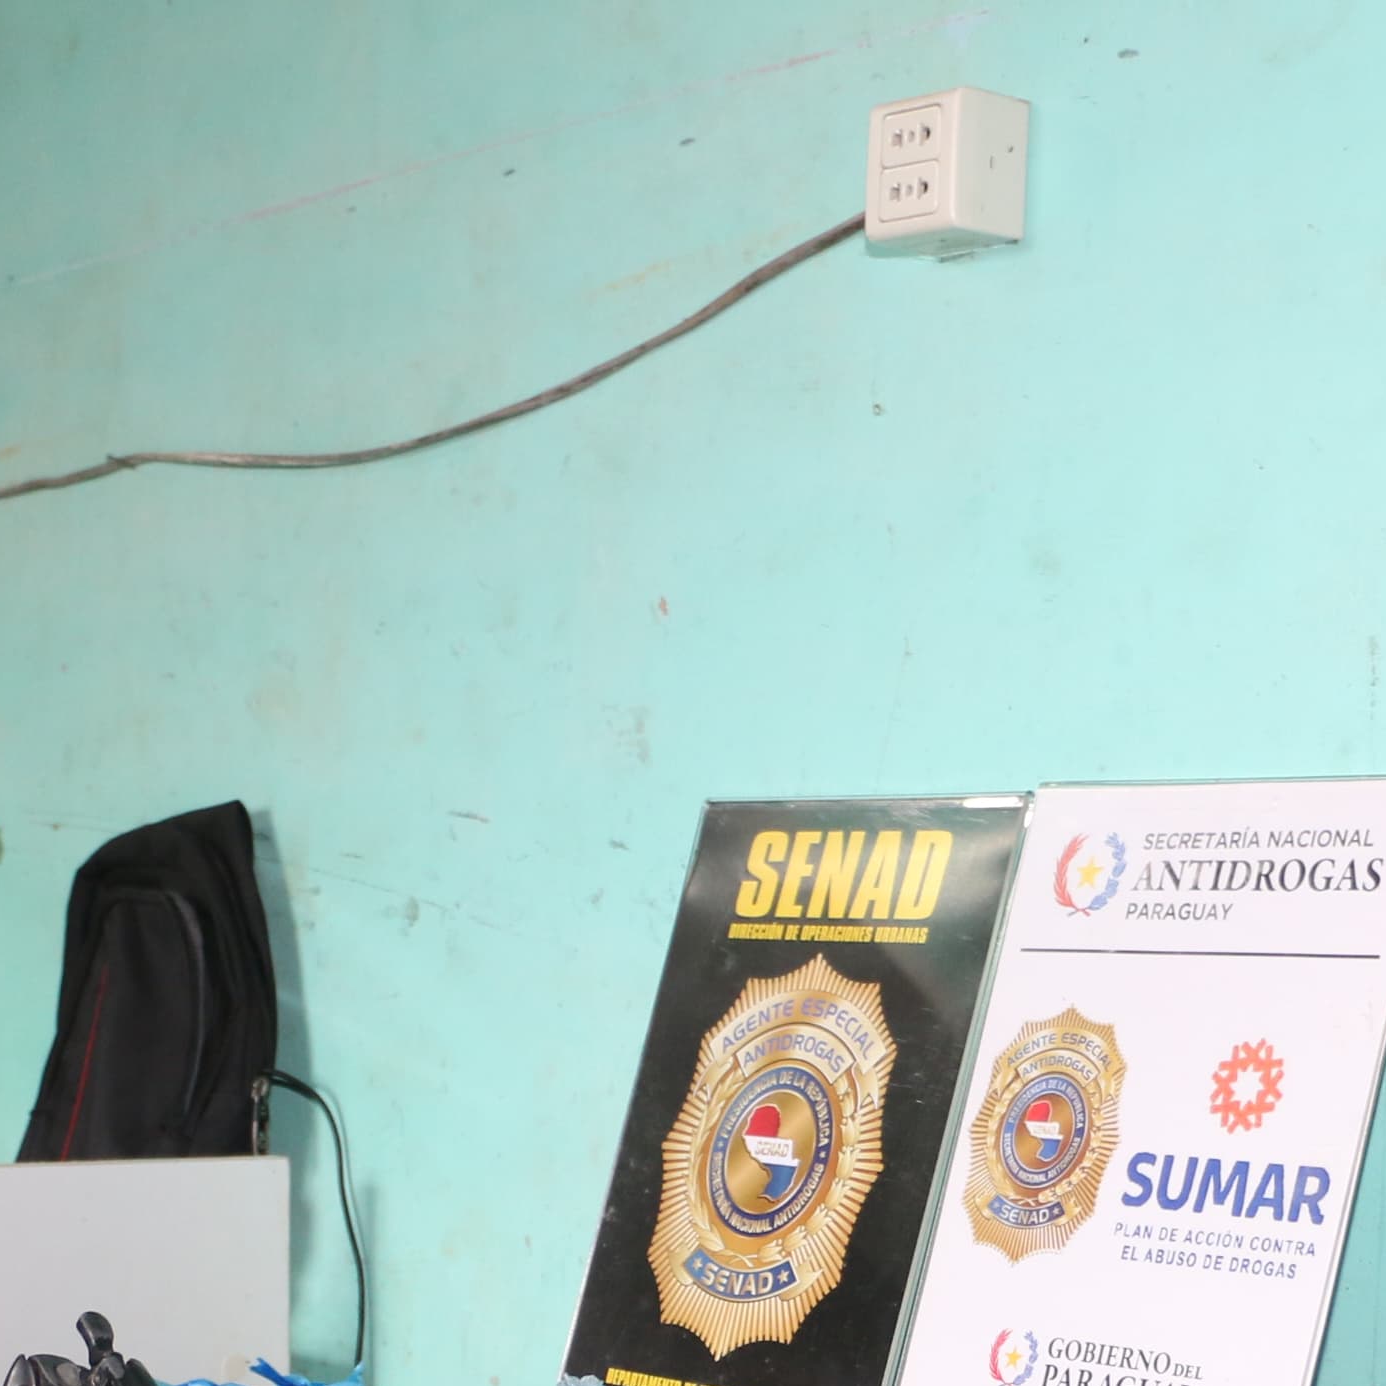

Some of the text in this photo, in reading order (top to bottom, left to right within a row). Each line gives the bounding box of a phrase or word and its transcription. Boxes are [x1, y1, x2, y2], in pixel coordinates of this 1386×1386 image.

[1143, 827, 1374, 850] SECRETARÍA NACIONAL
[735, 829, 954, 921] SENAD
[1131, 857, 1385, 892] ANTIDROGAS
[1125, 902, 1233, 921] PARAGUAY
[784, 924, 801, 941] DE
[800, 925, 873, 943] OPERACIONES
[874, 926, 929, 944] URBANAS
[721, 997, 876, 1060] AGENTE ESPECIAL
[743, 1034, 845, 1073] ANTIDROGAS
[1007, 1032, 1113, 1070] AGENTE ESPECIAL
[1022, 1055, 1093, 1081] ANTIDROGAS
[779, 1072, 793, 1085] DE
[793, 1074, 805, 1089] LA
[773, 1163, 824, 1229] ANTIDROGAS
[1121, 1152, 1330, 1225] SUMAR
[999, 1204, 1049, 1224] SENAD
[1113, 1222, 1153, 1239] PLAN
[1158, 1226, 1178, 1242] DE
[1249, 1236, 1316, 1256] CONTRA
[701, 1262, 773, 1295] SENAD
[1121, 1245, 1297, 1279] EL ABUSO DE DROGAS
[1047, 1337, 1204, 1380] GOBIERNO DEL
